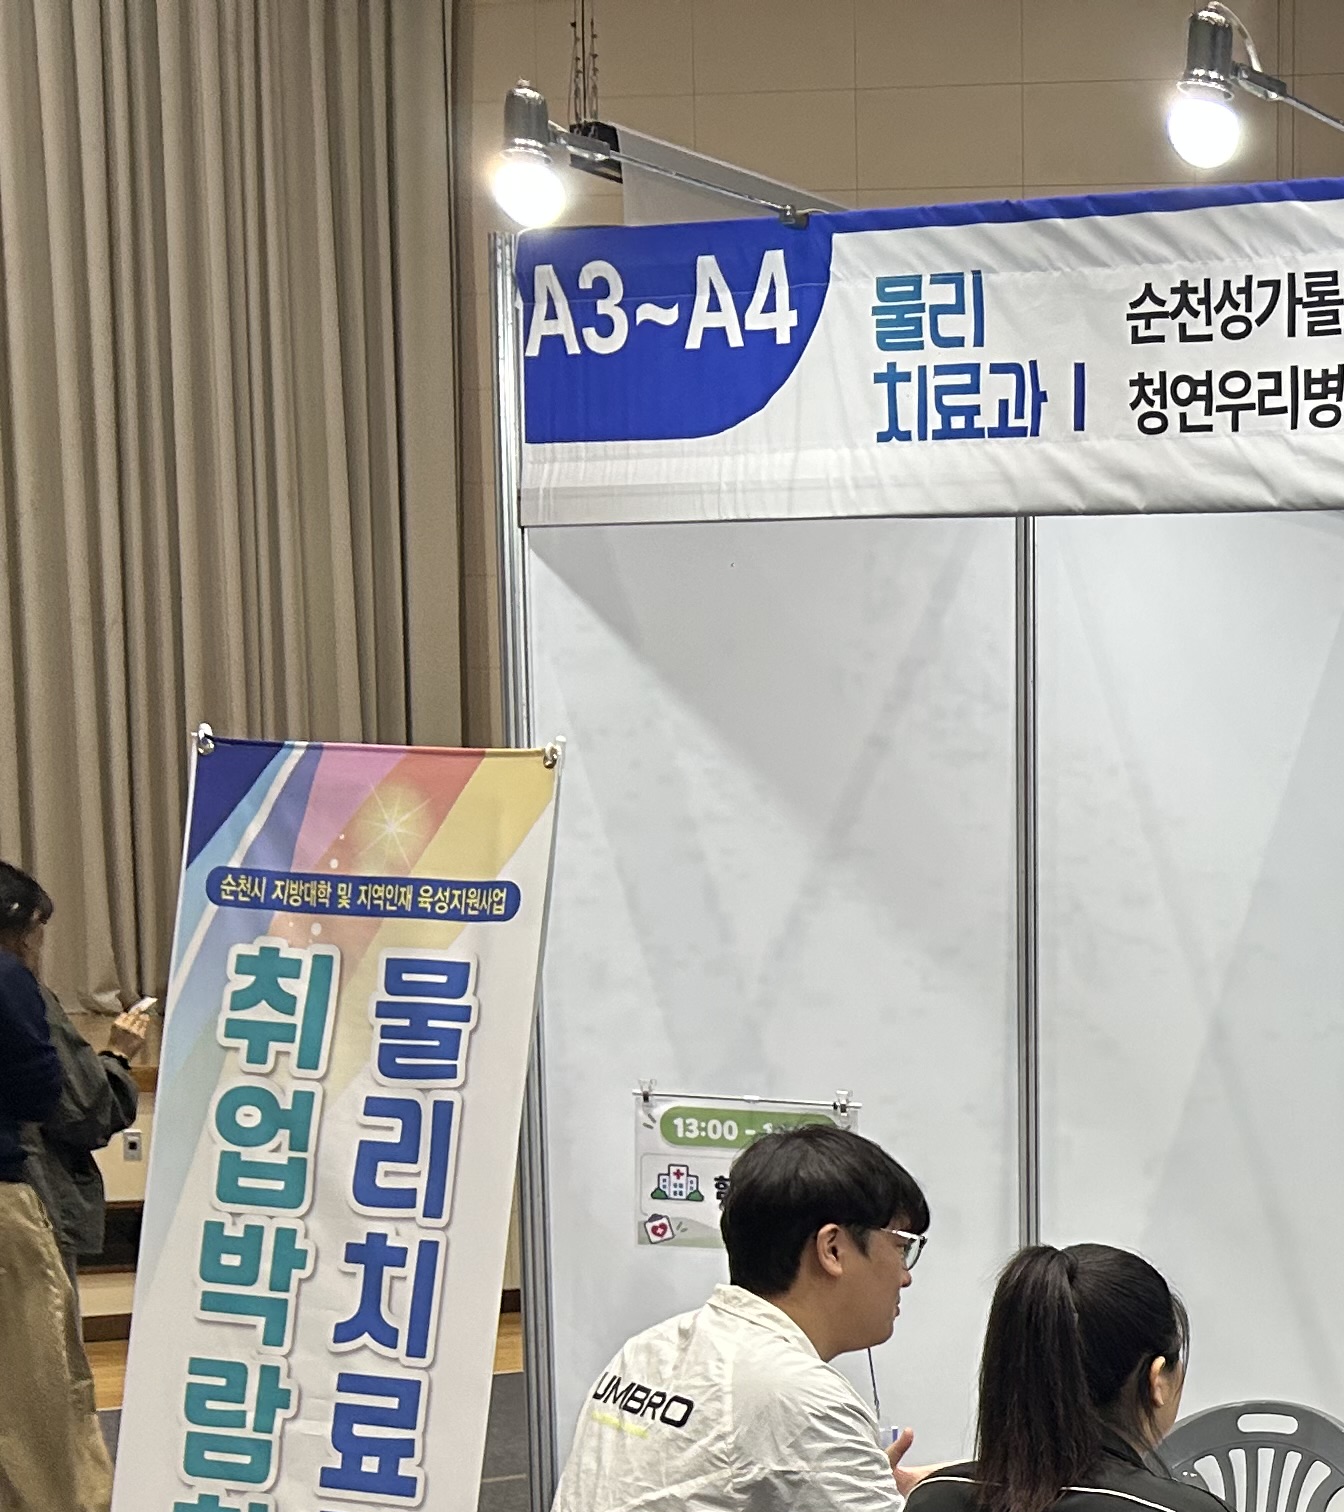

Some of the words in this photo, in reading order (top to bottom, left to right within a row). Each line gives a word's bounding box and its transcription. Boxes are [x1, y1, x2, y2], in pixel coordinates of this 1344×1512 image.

[524, 248, 798, 357] A3~A4
[871, 270, 984, 352] 물리
[872, 359, 1048, 442] 치료과
[220, 873, 266, 902] 순천시
[271, 878, 332, 908] 지방대학
[337, 882, 351, 909] 및
[357, 883, 413, 912] 지역인재
[417, 885, 507, 915] 육성지원사업
[673, 1117, 738, 1140] 13:00
[593, 1372, 694, 1428] UMBRO
